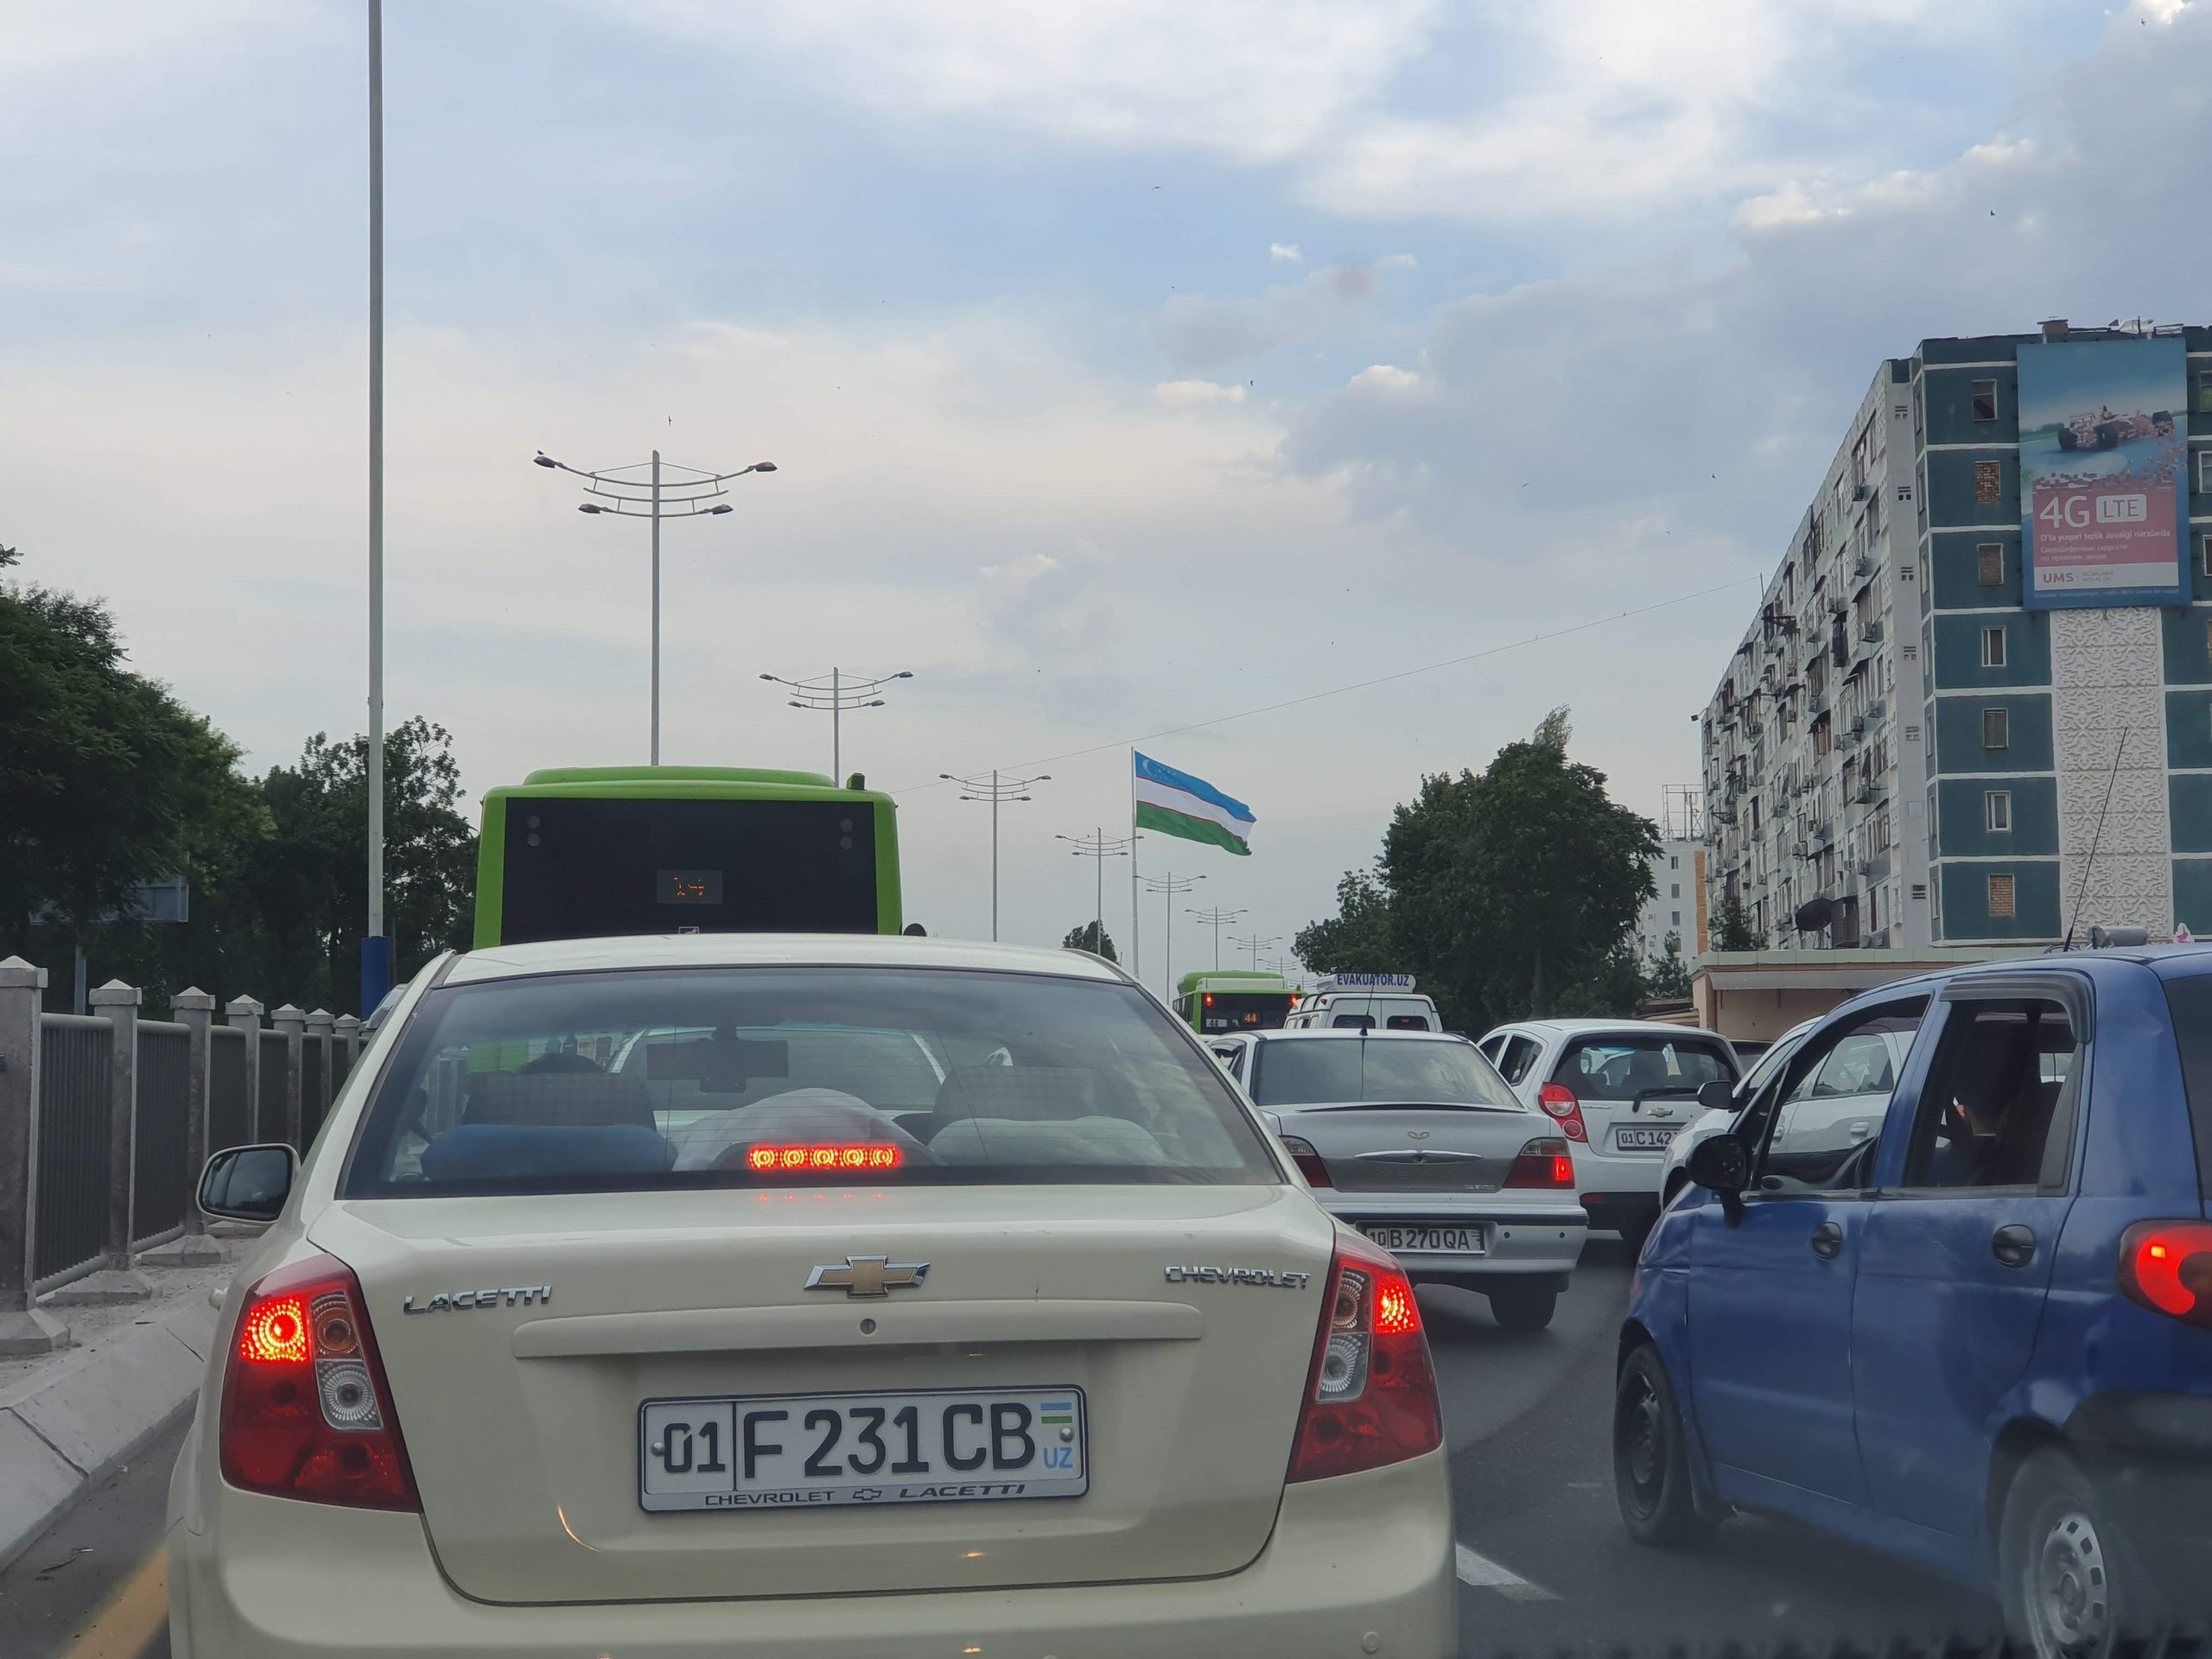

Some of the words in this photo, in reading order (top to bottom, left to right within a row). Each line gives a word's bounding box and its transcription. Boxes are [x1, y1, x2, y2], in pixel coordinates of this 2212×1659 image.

[2039, 495, 2090, 528] 4G
[2103, 499, 2139, 518] LTE
[2057, 531, 2082, 543] yuqori
[2083, 531, 2104, 541] tezlik
[2106, 530, 2133, 540] avvalgi
[2134, 528, 2171, 538] narxlarda
[2043, 572, 2075, 583] UMS
[1337, 974, 1409, 986] EVAKUATOR.UZ
[1244, 1013, 1258, 1023] 44
[1165, 1266, 1311, 1290] CHEVROLET
[403, 1285, 552, 1315] LACETTI
[1043, 1445, 1074, 1471] UZ
[704, 1491, 836, 1507] CHEVROLET
[899, 1484, 1028, 1500] LACETTI
